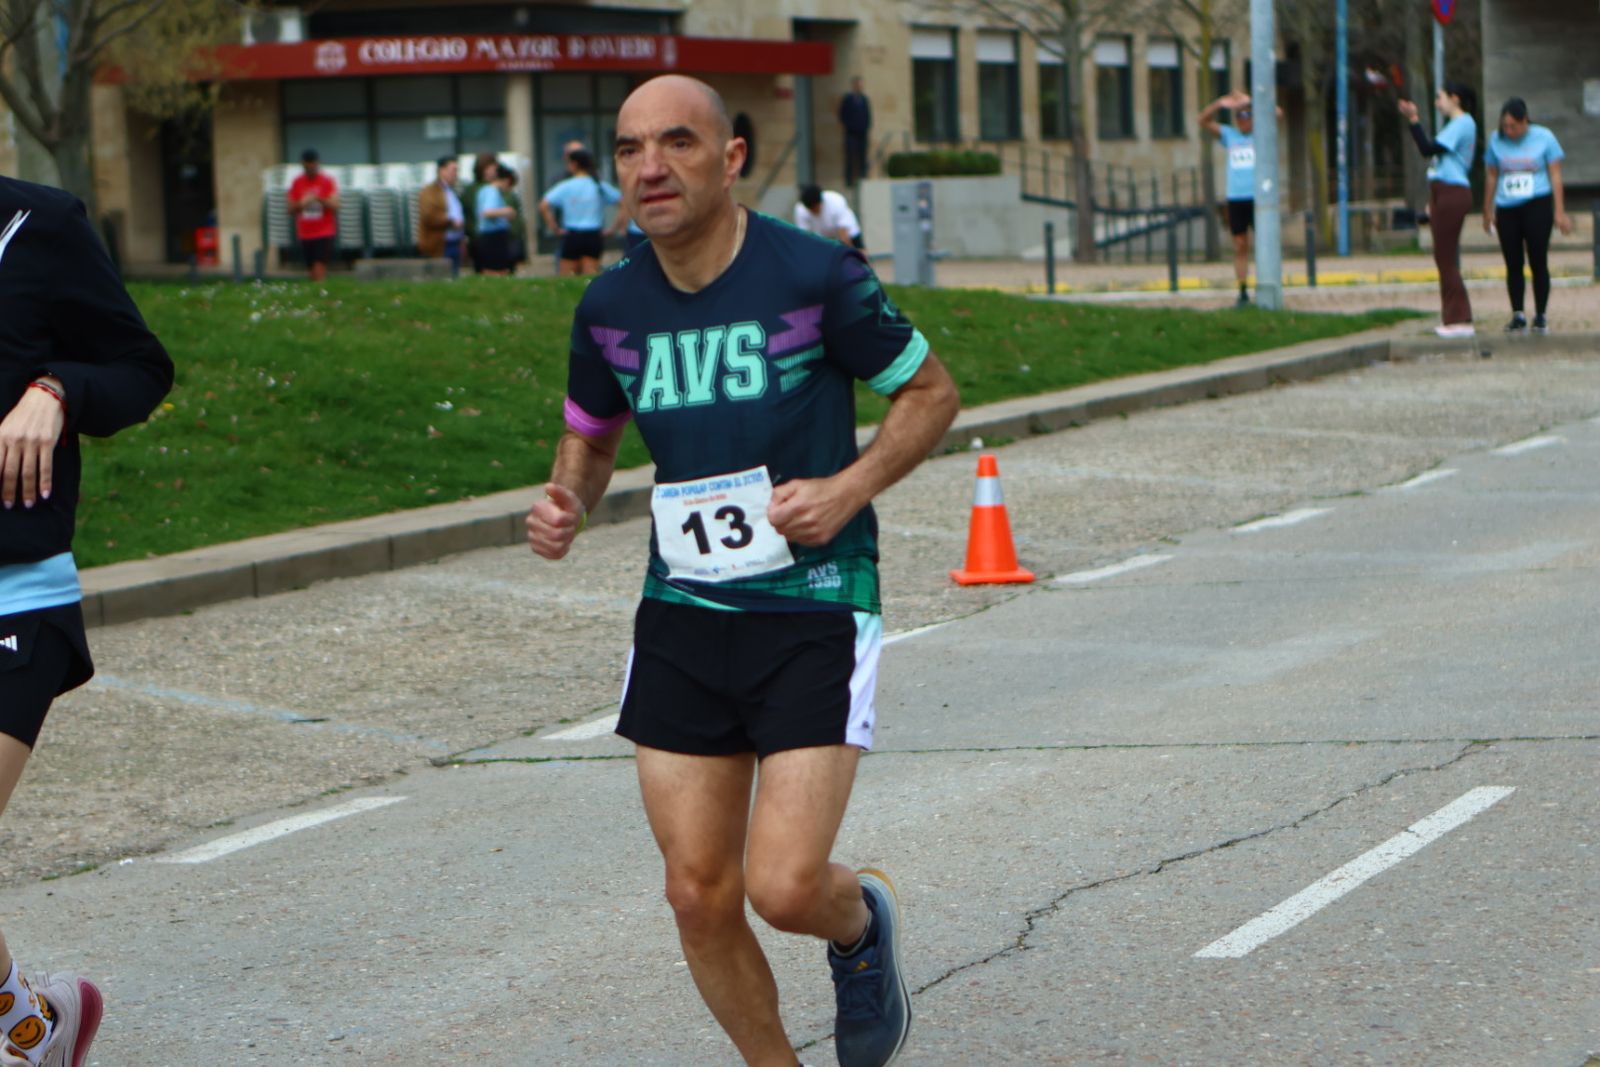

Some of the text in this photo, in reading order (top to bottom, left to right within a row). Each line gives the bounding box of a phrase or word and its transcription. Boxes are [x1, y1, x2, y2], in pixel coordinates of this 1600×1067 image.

[358, 37, 468, 64] COLEGIO
[474, 36, 563, 60] MAYOR
[637, 320, 768, 412] AVS
[681, 504, 754, 555] 13
[808, 561, 838, 579] AVS
